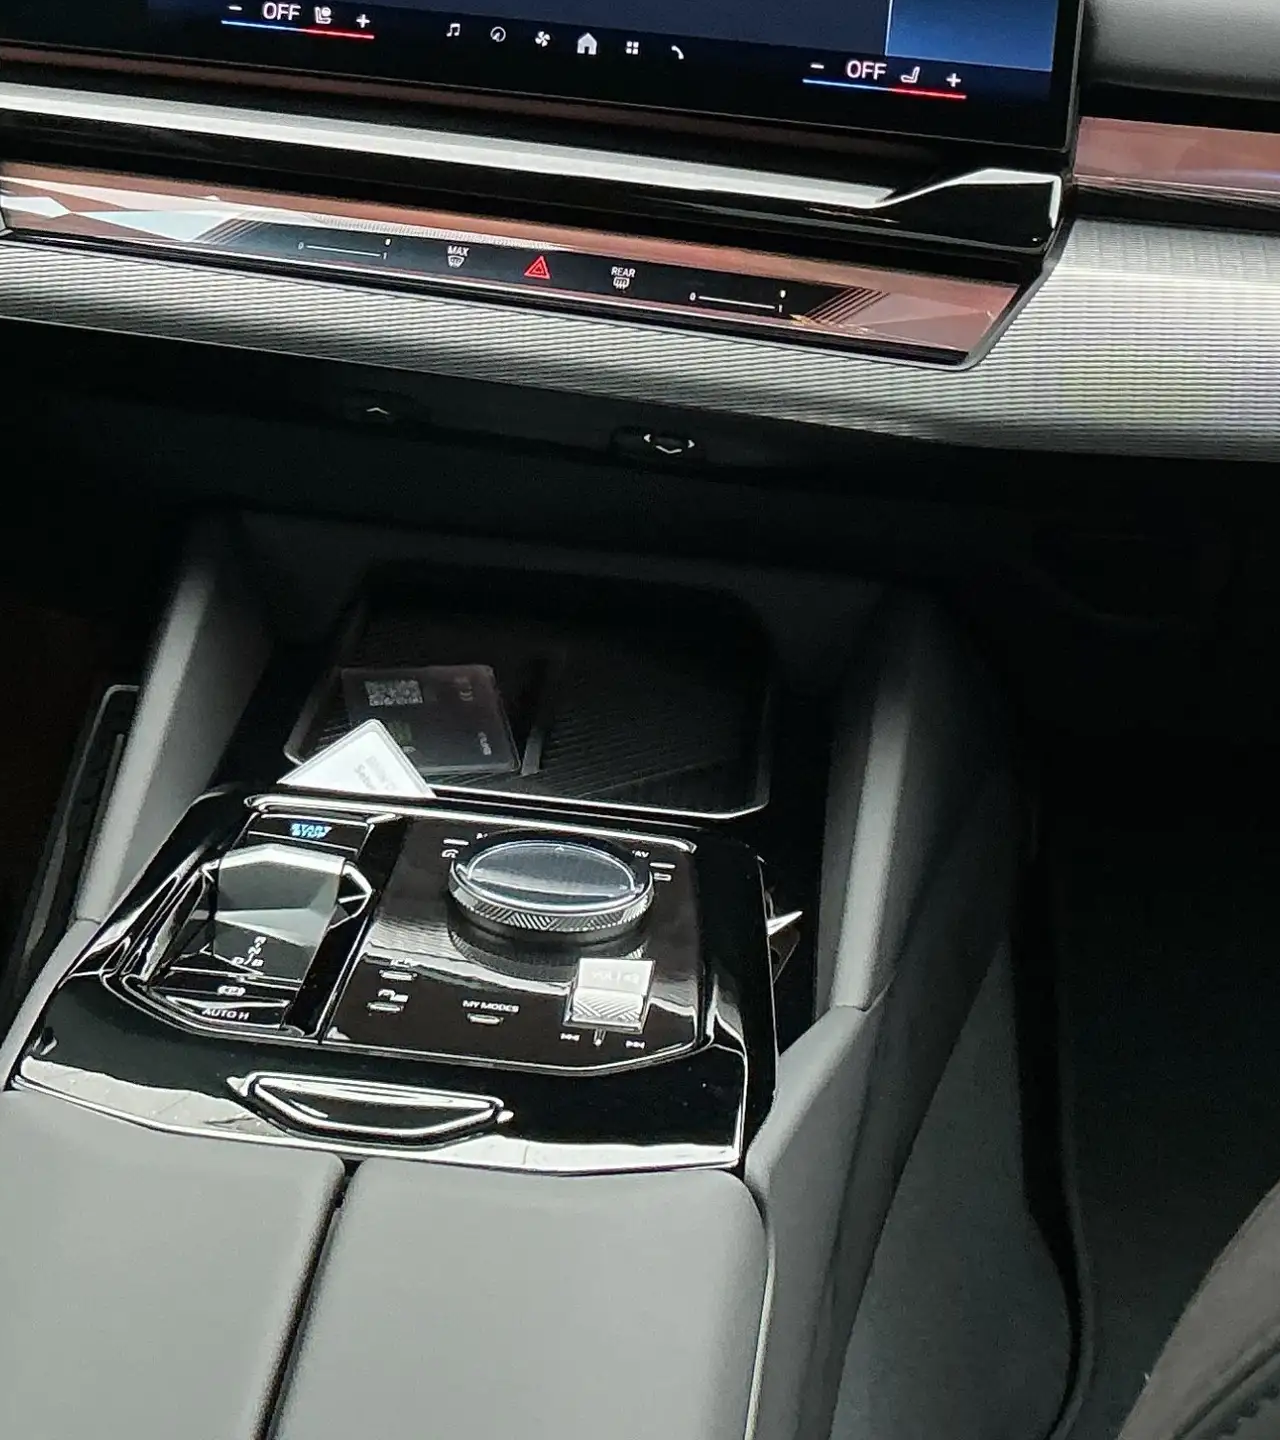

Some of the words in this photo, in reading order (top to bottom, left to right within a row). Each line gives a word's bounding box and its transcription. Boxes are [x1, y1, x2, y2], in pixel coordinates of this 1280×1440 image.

[262, 1, 302, 21] OFF
[846, 59, 888, 80] OFF
[447, 244, 470, 257] MAX
[610, 265, 636, 278] REAR
[461, 999, 483, 1010] MY
[483, 1001, 520, 1013] MODES
[201, 1008, 237, 1019] AUTO
[238, 1011, 250, 1021] H
